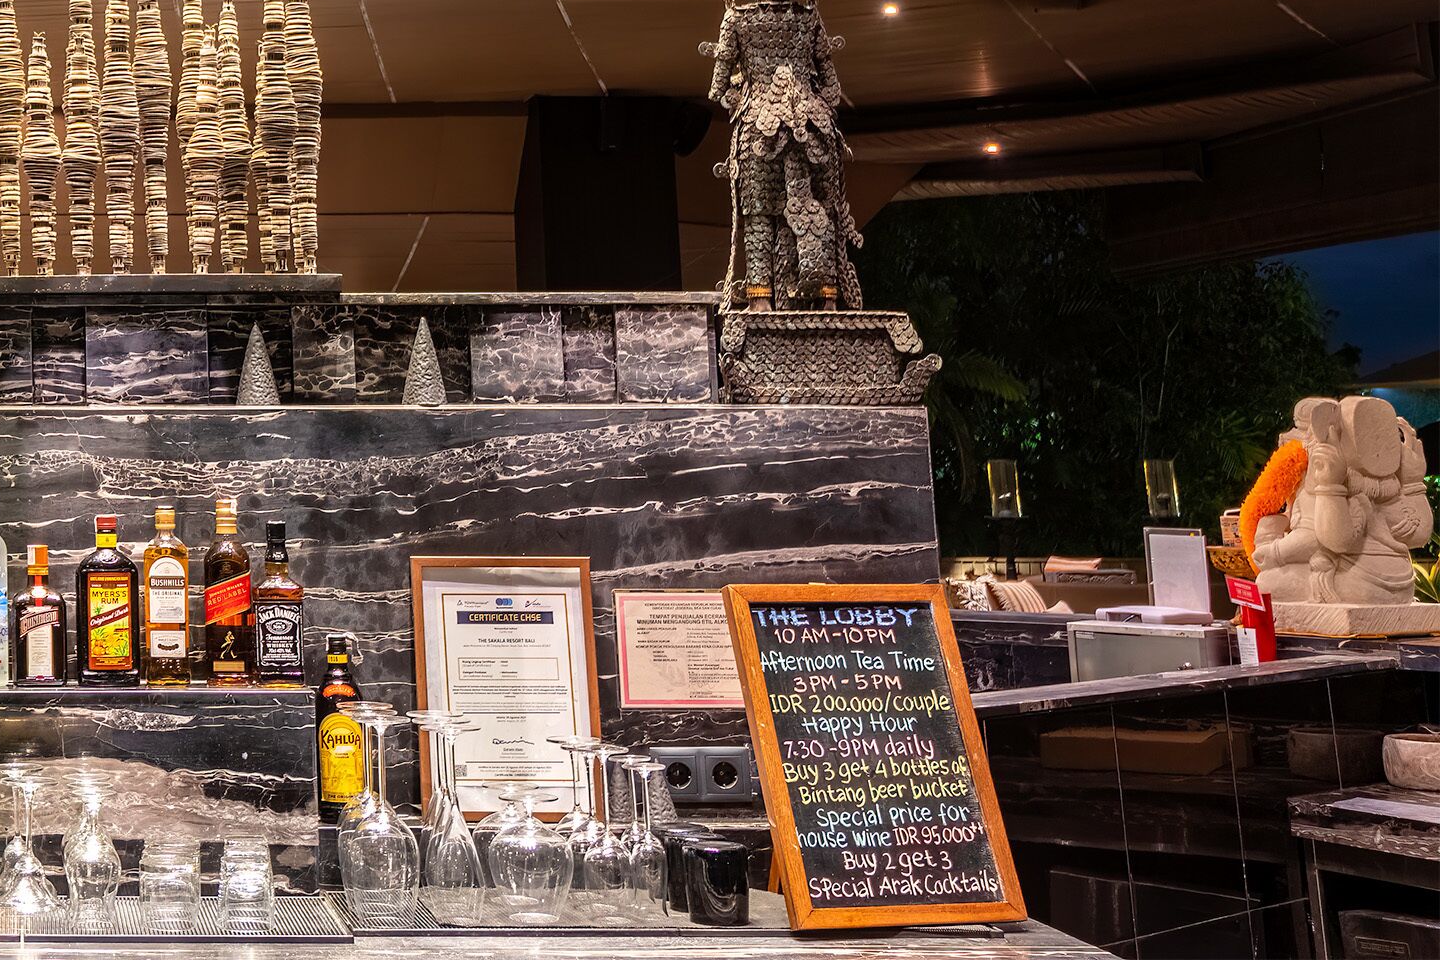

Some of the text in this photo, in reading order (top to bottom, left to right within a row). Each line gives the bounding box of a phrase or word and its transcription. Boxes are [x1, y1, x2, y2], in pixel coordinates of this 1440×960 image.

[150, 579, 185, 587] BUSHMILLS
[208, 588, 247, 606] RED LABEL
[90, 607, 129, 626] Original Dark
[259, 607, 300, 623] JACK DANIEL'S
[469, 614, 542, 622] CERTIFICATE CHSE
[752, 607, 918, 627] THE LOBBY
[774, 628, 796, 644] 10
[801, 628, 830, 644] AM
[760, 650, 847, 674] Afternoon
[851, 650, 885, 670] Tea
[888, 650, 936, 672] Time
[769, 694, 807, 715] IDR
[802, 713, 918, 742] Happy Hour
[321, 730, 361, 750] KAHLÚA
[784, 740, 825, 759] 7.30
[885, 735, 935, 760] daily
[782, 755, 967, 786] Buy 3 get 4 bottles of
[798, 779, 969, 807] Bintang beer bucket
[816, 802, 971, 834] Special price for
[795, 826, 848, 849] house
[893, 827, 921, 846] IDR
[842, 850, 954, 877] Buy 2 get 3
[879, 877, 924, 898] Arak
[924, 870, 998, 896] Cocktails
